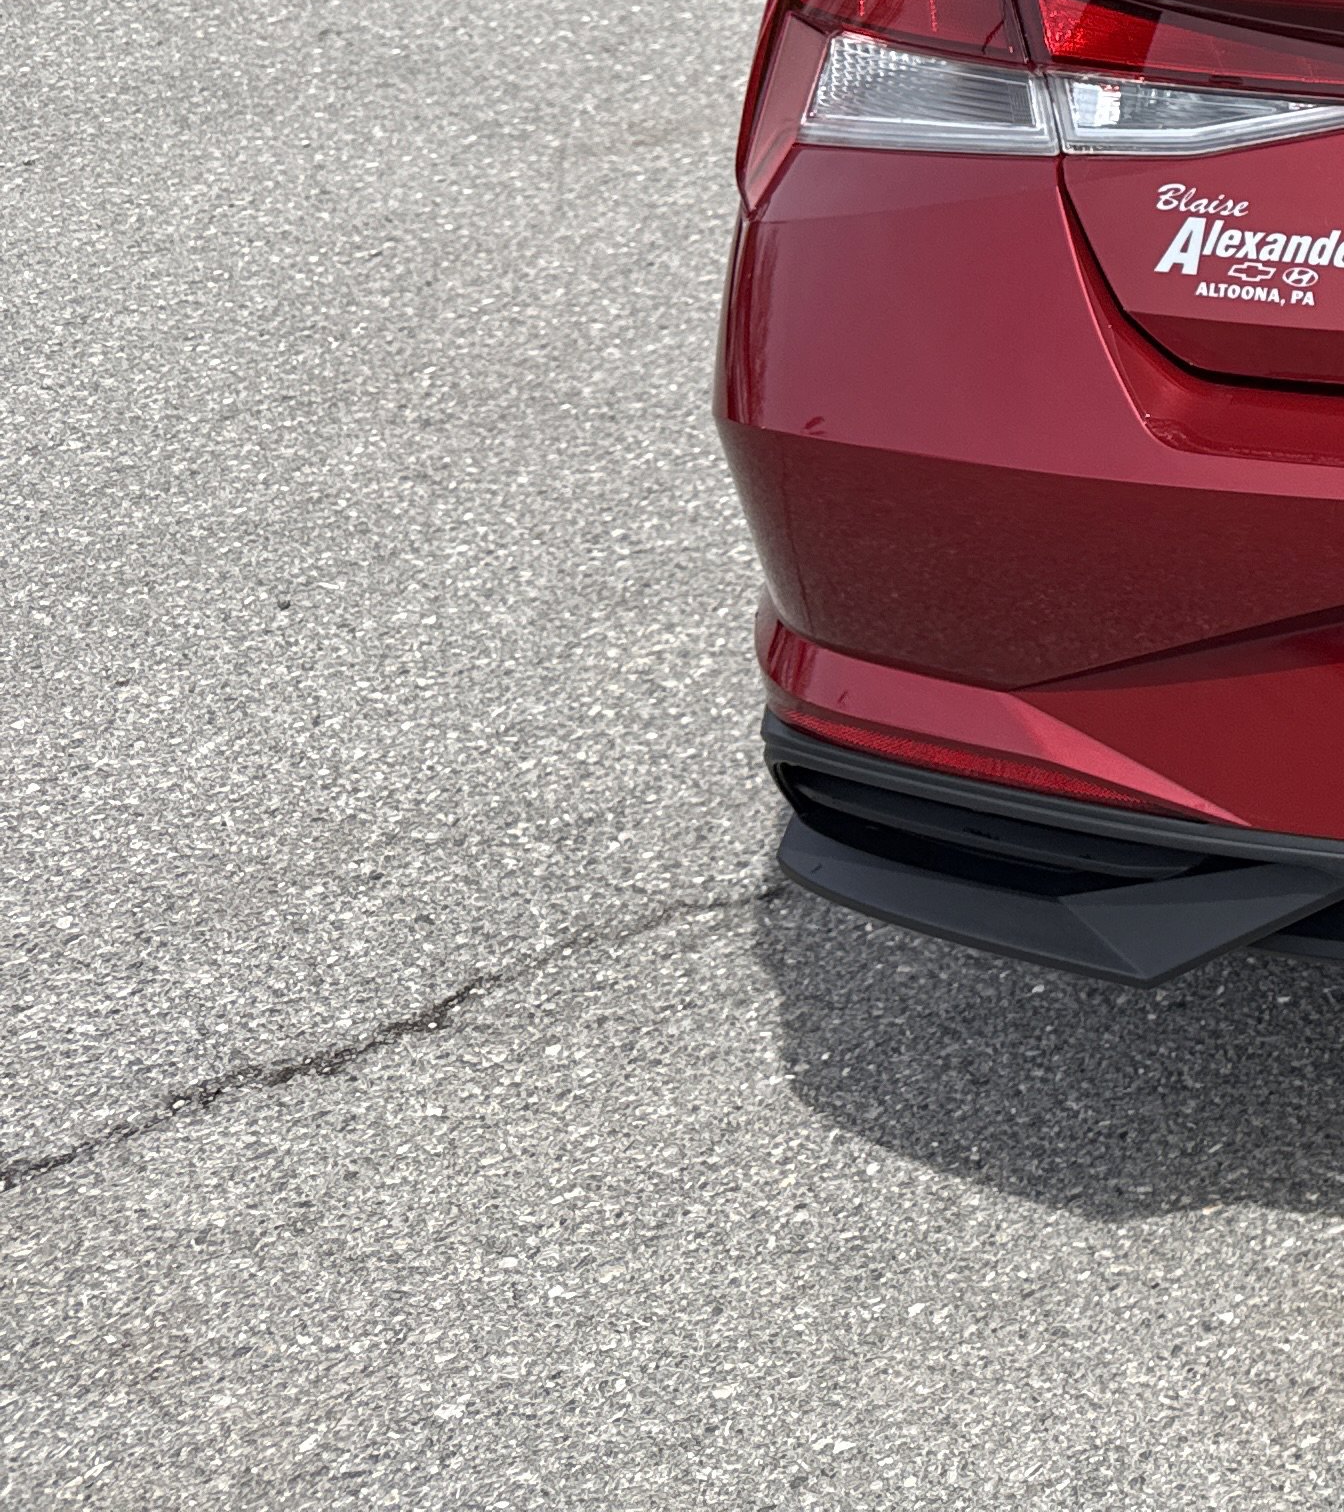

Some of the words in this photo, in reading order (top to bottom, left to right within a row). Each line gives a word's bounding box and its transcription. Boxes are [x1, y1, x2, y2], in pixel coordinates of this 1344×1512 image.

[1156, 183, 1249, 217] Blaise
[1195, 281, 1286, 307] ALTOONA,
[1290, 290, 1315, 306] PA
